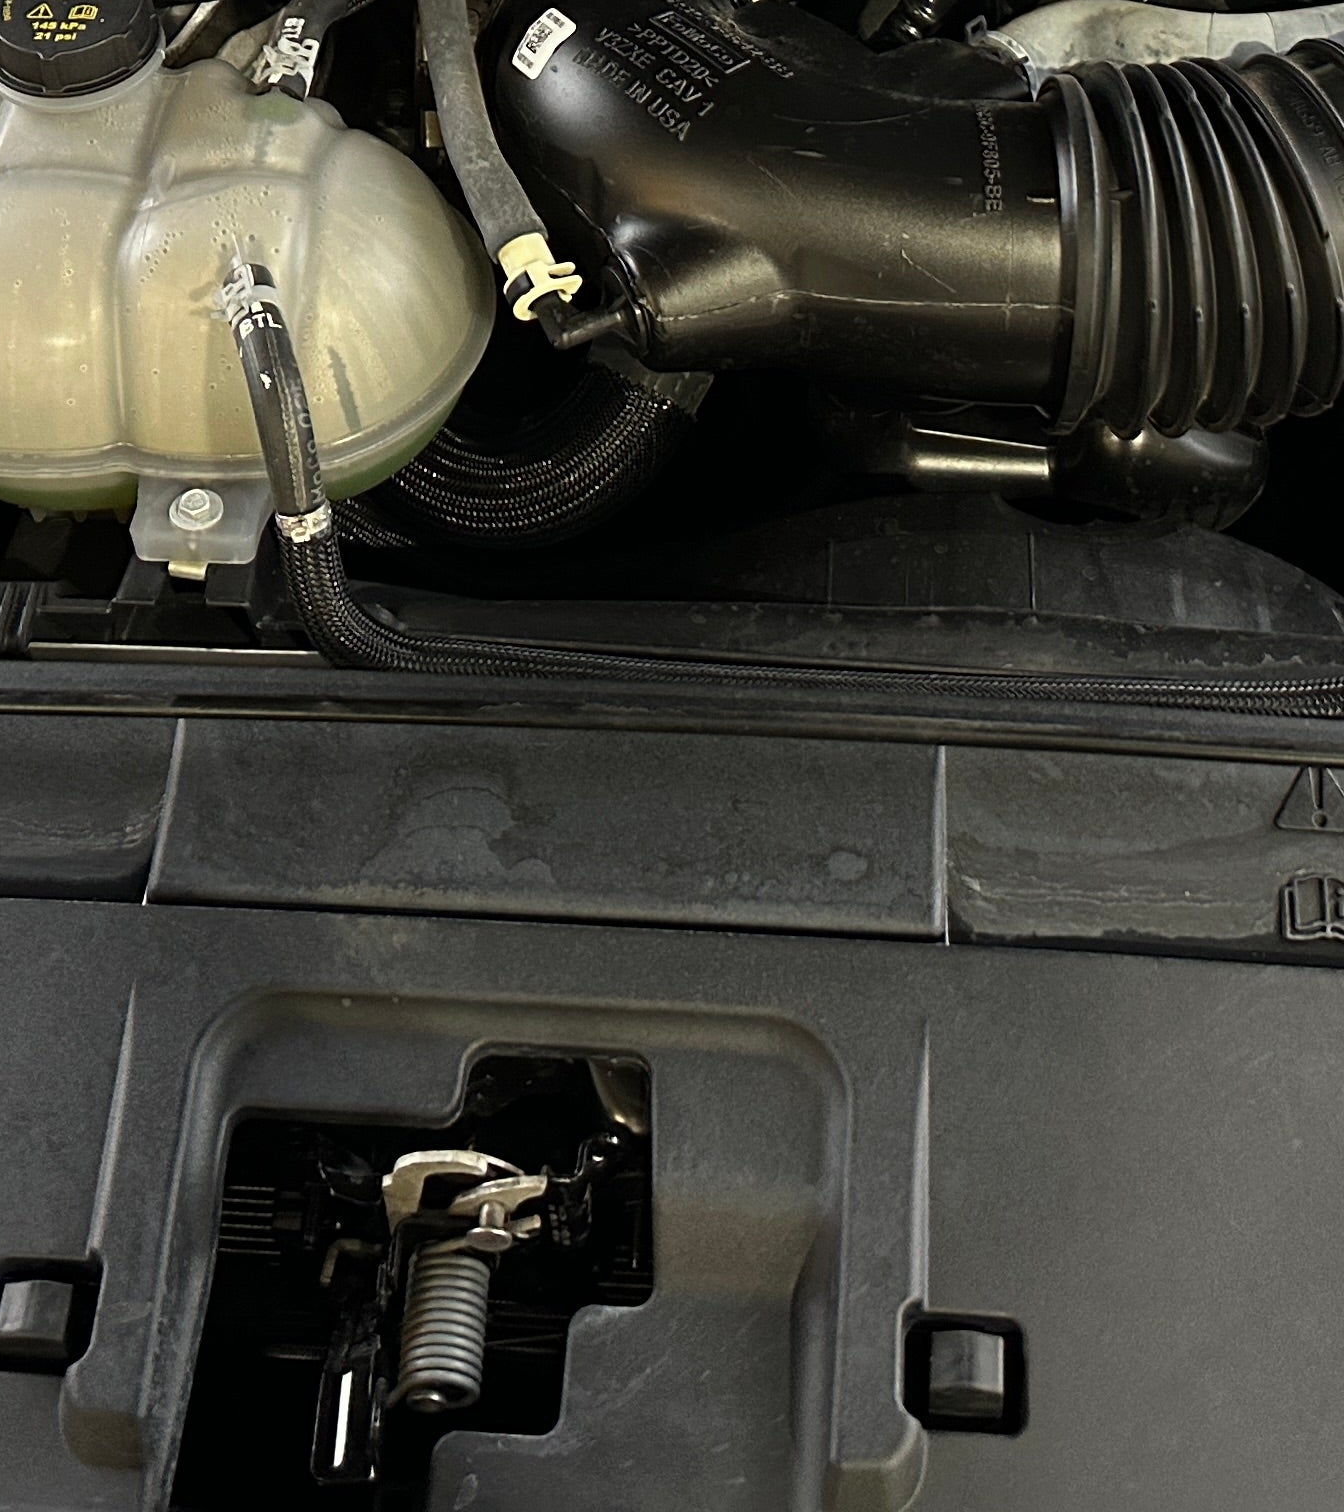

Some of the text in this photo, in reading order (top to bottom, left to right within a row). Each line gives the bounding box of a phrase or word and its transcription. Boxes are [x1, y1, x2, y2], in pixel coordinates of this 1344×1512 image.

[658, 11, 736, 68] FoMoCo
[624, 75, 653, 104] IN
[645, 91, 694, 143] USA
[238, 312, 283, 340] BTL
